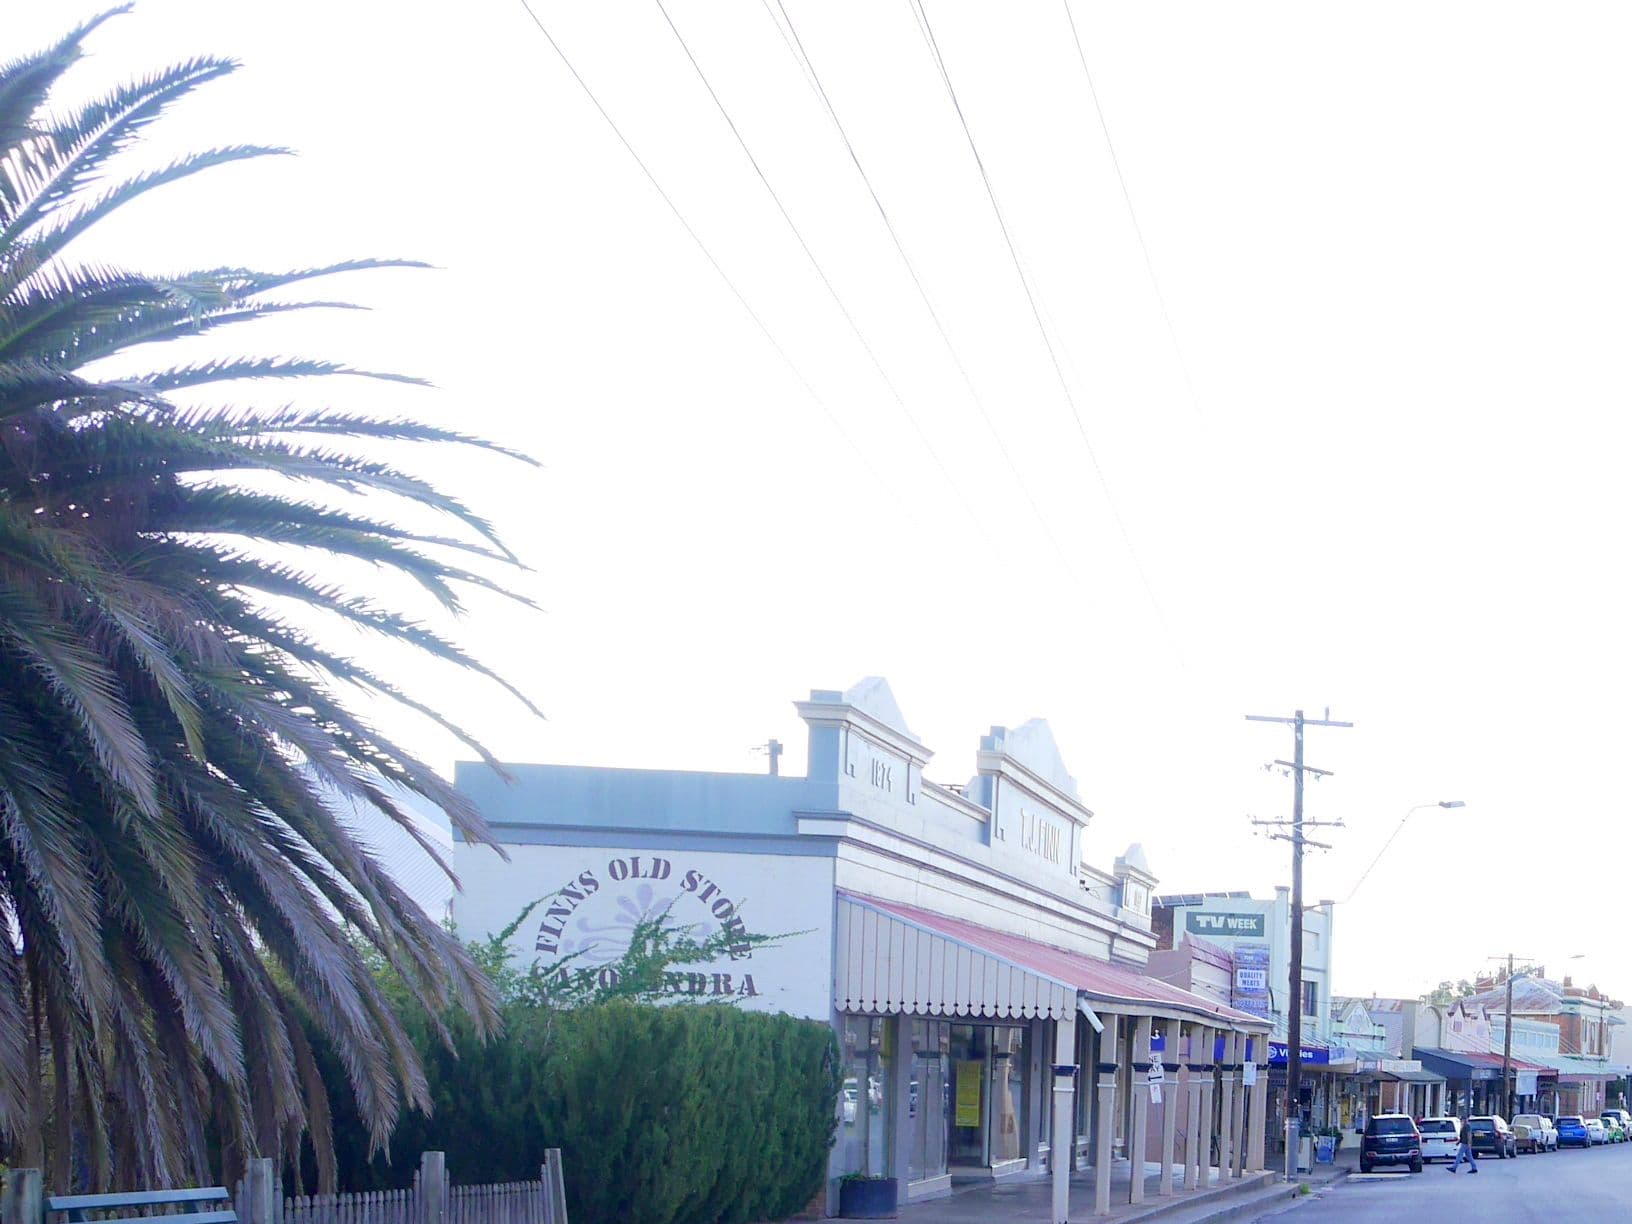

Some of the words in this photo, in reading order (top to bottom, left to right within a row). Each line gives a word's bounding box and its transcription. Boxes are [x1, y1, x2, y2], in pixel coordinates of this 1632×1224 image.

[535, 870, 600, 955] FINNS
[608, 856, 672, 882] OLD
[680, 869, 752, 961] STORE
[1196, 915, 1225, 928] TV
[1227, 918, 1257, 930] WEEK
[1240, 971, 1262, 979] QUALITY
[1242, 979, 1260, 987] MEATS
[1279, 1047, 1314, 1059] Viies
